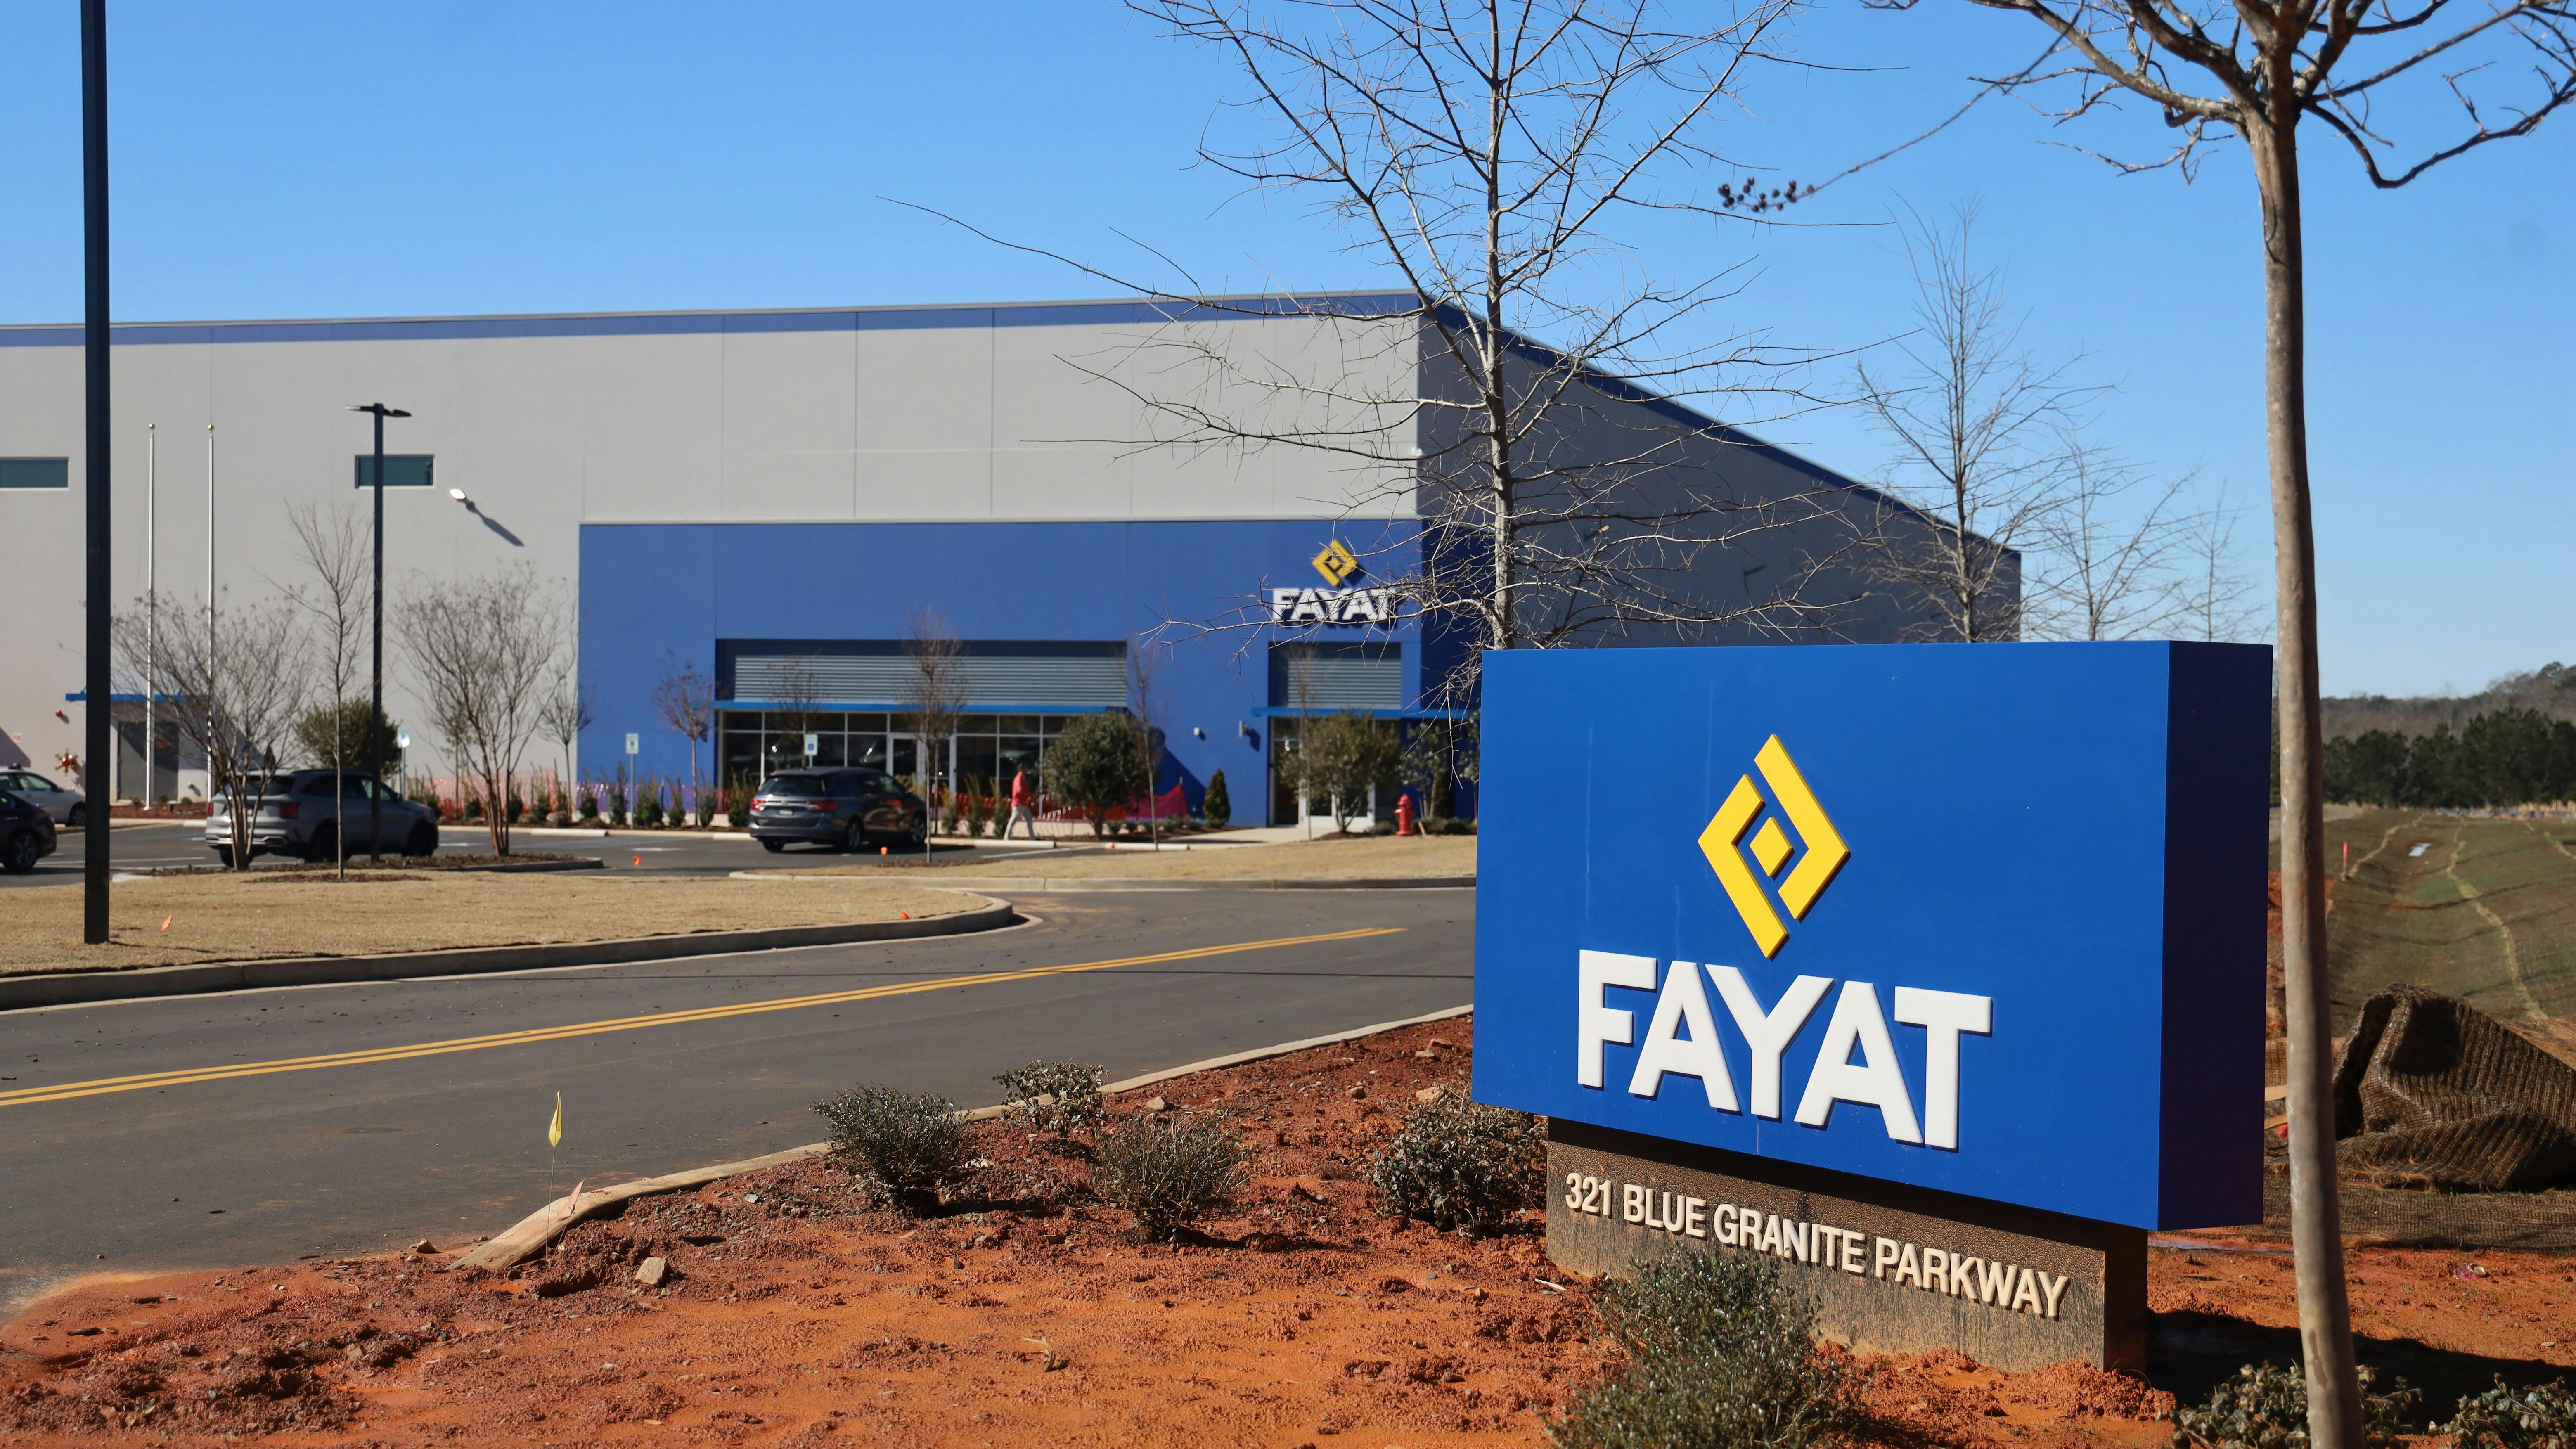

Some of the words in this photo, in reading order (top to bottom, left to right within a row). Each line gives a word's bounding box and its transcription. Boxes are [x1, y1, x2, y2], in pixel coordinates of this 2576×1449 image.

[1273, 587, 1396, 620] FAYAT
[1578, 949, 1991, 1149] FAYAT
[1565, 1172, 1612, 1216] 321
[1624, 1184, 1706, 1238] BLUE
[1714, 1204, 1866, 1274] GRANITE
[1875, 1237, 2069, 1317] PARKWAY
